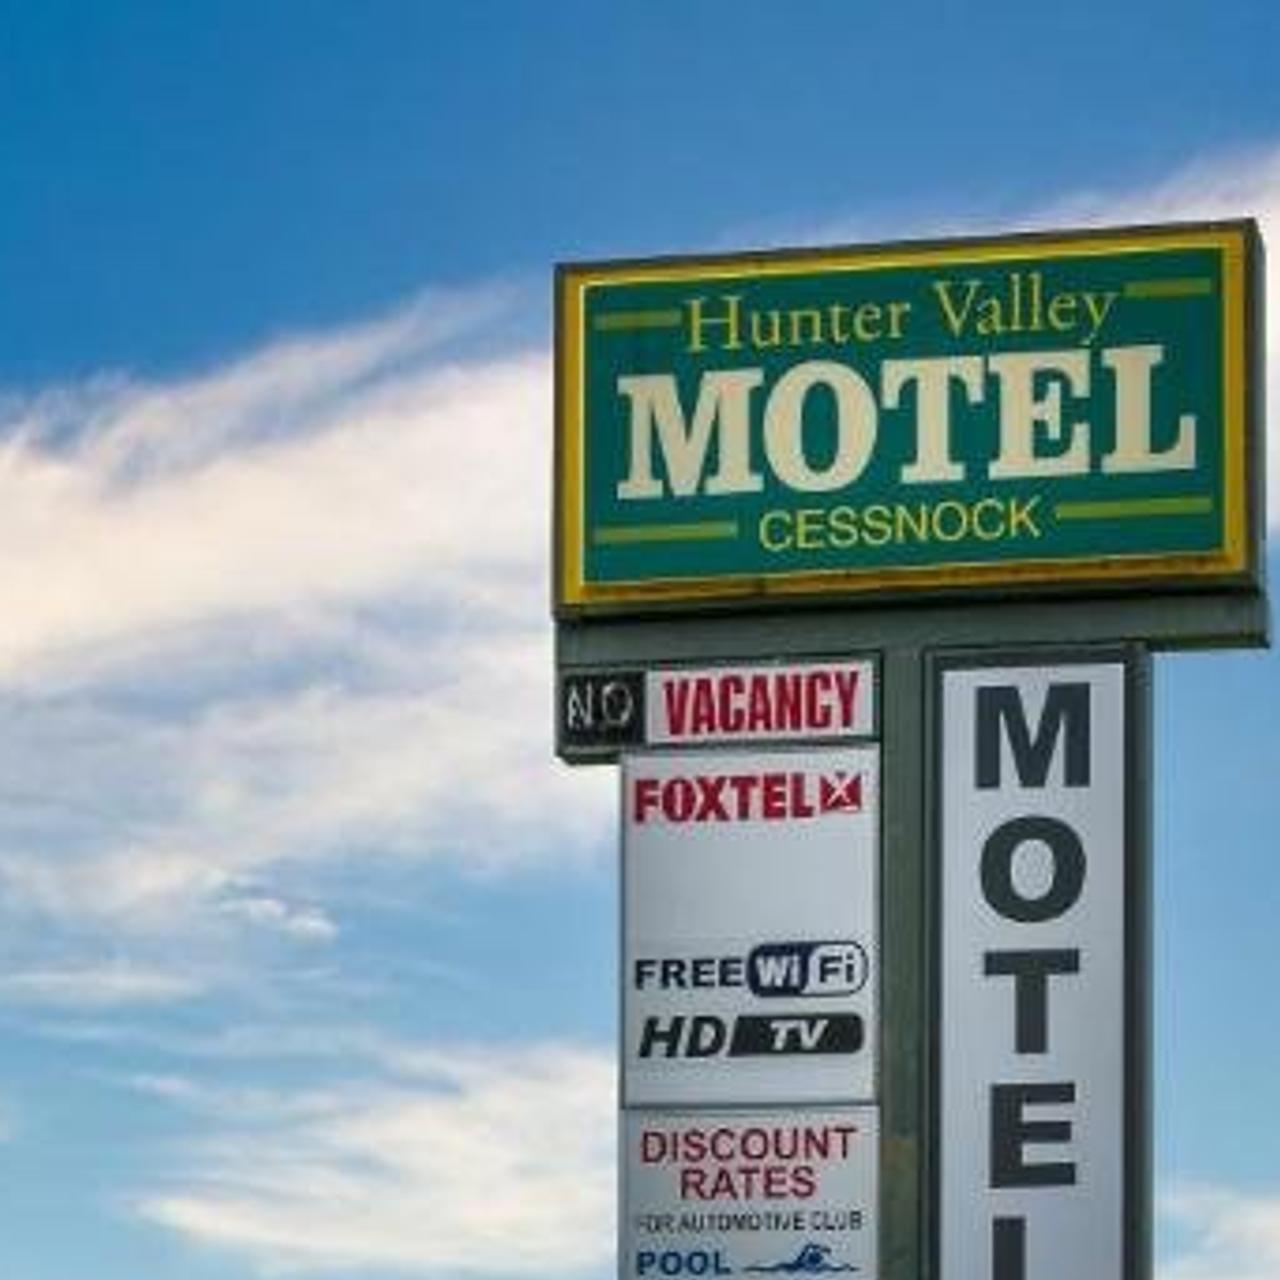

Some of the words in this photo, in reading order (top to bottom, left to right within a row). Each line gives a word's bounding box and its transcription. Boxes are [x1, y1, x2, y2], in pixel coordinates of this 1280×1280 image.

[683, 294, 911, 354] Hunter
[933, 273, 1121, 346] Valley
[618, 345, 1196, 499] MOTEL
[758, 496, 1043, 552] CESSNOCK
[567, 681, 634, 729] NO
[663, 669, 860, 736] VACANCY
[634, 771, 814, 824] FOXTEL
[634, 957, 743, 990] FREE
[638, 1014, 728, 1058] HD
[770, 1018, 829, 1051] TV
[640, 1127, 858, 1164] DISCOUNT
[680, 1165, 817, 1200] RATES
[677, 1211, 806, 1233] AUTOMOTIVE
[811, 1209, 863, 1231] CLUB
[635, 1250, 732, 1276] POOL
